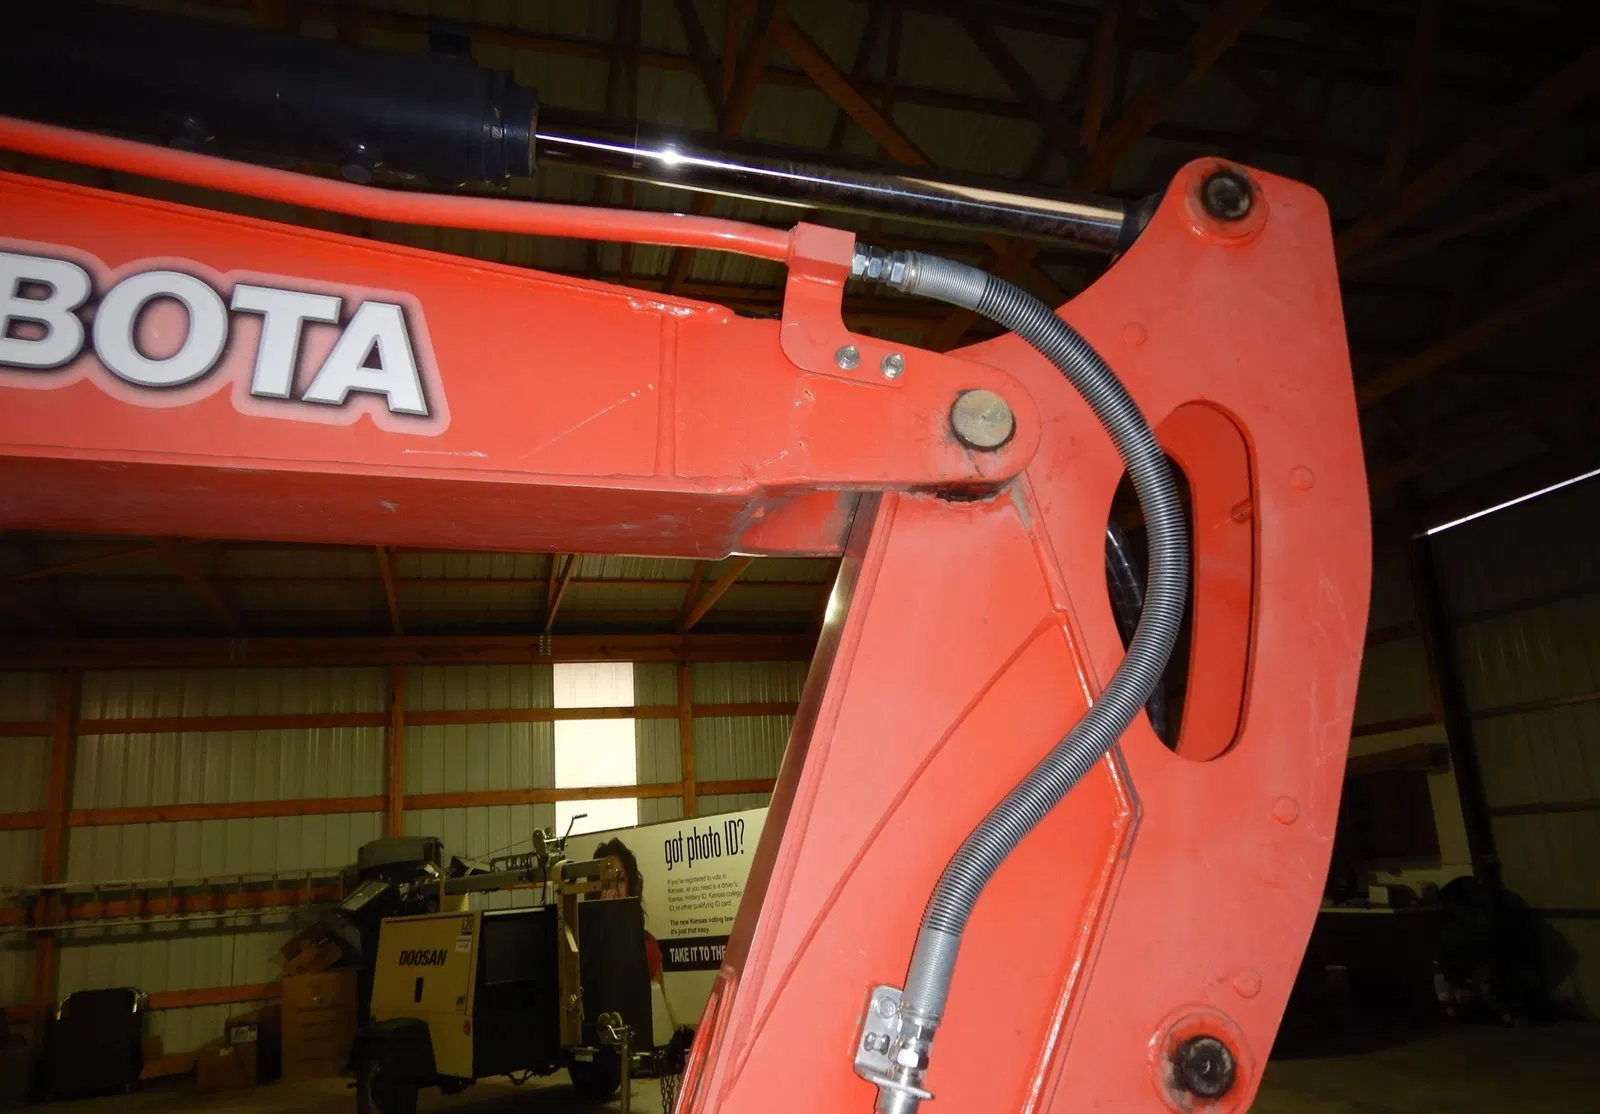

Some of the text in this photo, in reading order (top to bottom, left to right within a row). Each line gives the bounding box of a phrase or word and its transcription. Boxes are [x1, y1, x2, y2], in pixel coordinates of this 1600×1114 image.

[664, 818, 744, 871] got photo ID?
[685, 875, 706, 885] registered
[691, 886, 699, 894] you
[721, 880, 738, 888] driver's
[685, 894, 701, 902] military
[693, 901, 714, 910] qualifying
[690, 917, 708, 925] Kansas
[708, 916, 724, 924] voting
[678, 928, 687, 936] just
[399, 949, 448, 966] DOOSAN
[669, 946, 690, 963] TAKE
[690, 946, 698, 962] IT
[698, 945, 710, 961] TO
